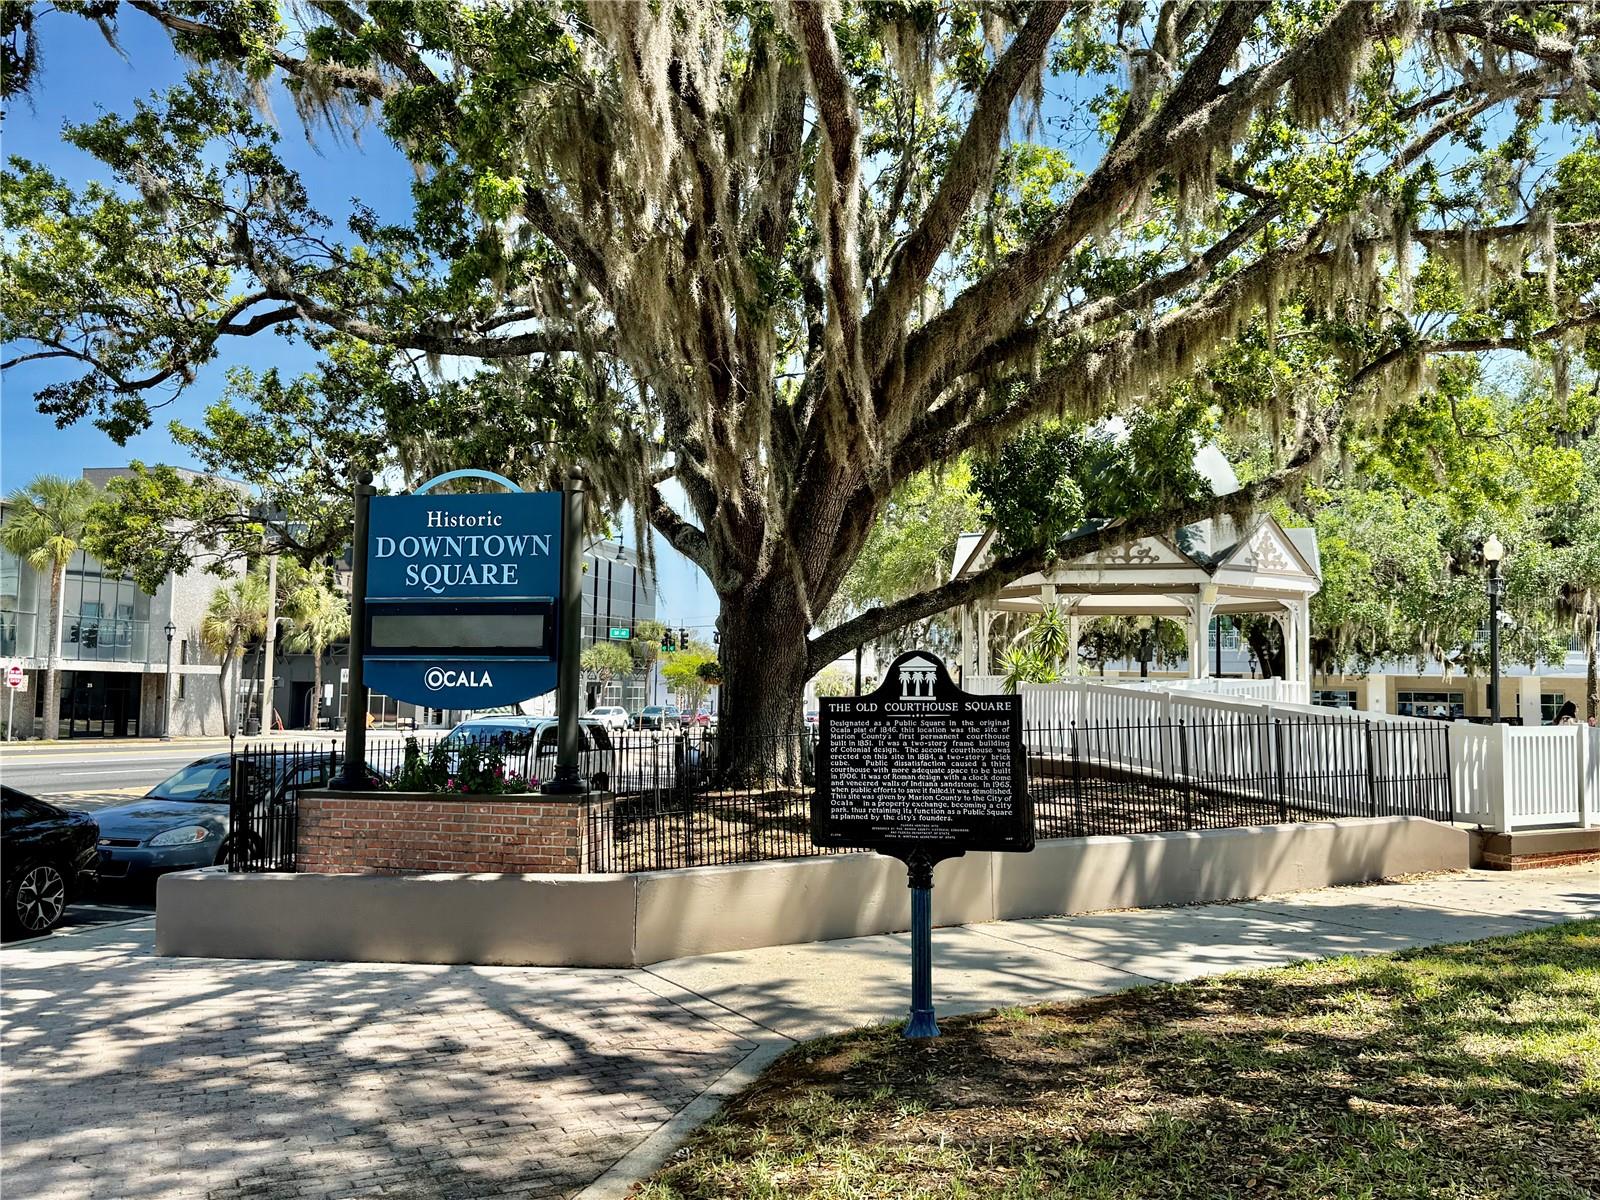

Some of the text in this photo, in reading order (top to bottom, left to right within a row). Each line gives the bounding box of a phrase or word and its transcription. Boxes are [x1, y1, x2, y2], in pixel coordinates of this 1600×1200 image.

[428, 511, 501, 527] Historic
[376, 535, 551, 557] DOWNTOWN
[406, 564, 518, 593] SQUARE
[425, 667, 492, 690] OCALA
[828, 702, 1012, 712] THE OLD COURTHOUSE SQUARE
[830, 720, 870, 728] Designated
[920, 719, 946, 728] Square
[979, 719, 1010, 727] original
[853, 726, 867, 734] plat
[861, 733, 892, 741] County's
[920, 733, 959, 741] permanent
[911, 740, 948, 748] two-story
[979, 740, 1010, 748] building
[873, 746, 900, 754] design.
[947, 753, 986, 762] two-story
[911, 767, 945, 775] adequate
[917, 773, 941, 782] design
[850, 786, 872, 794] public
[876, 793, 896, 802] given
[897, 794, 906, 802] by
[935, 794, 962, 802] County
[986, 794, 1003, 803] City
[877, 800, 910, 809] property
[951, 801, 987, 810] becoming
[996, 802, 1012, 810] city
[868, 807, 901, 815] retaining
[986, 808, 1013, 817] Square
[840, 813, 869, 822] planned
[870, 813, 880, 822] by
[896, 814, 916, 822] city's
